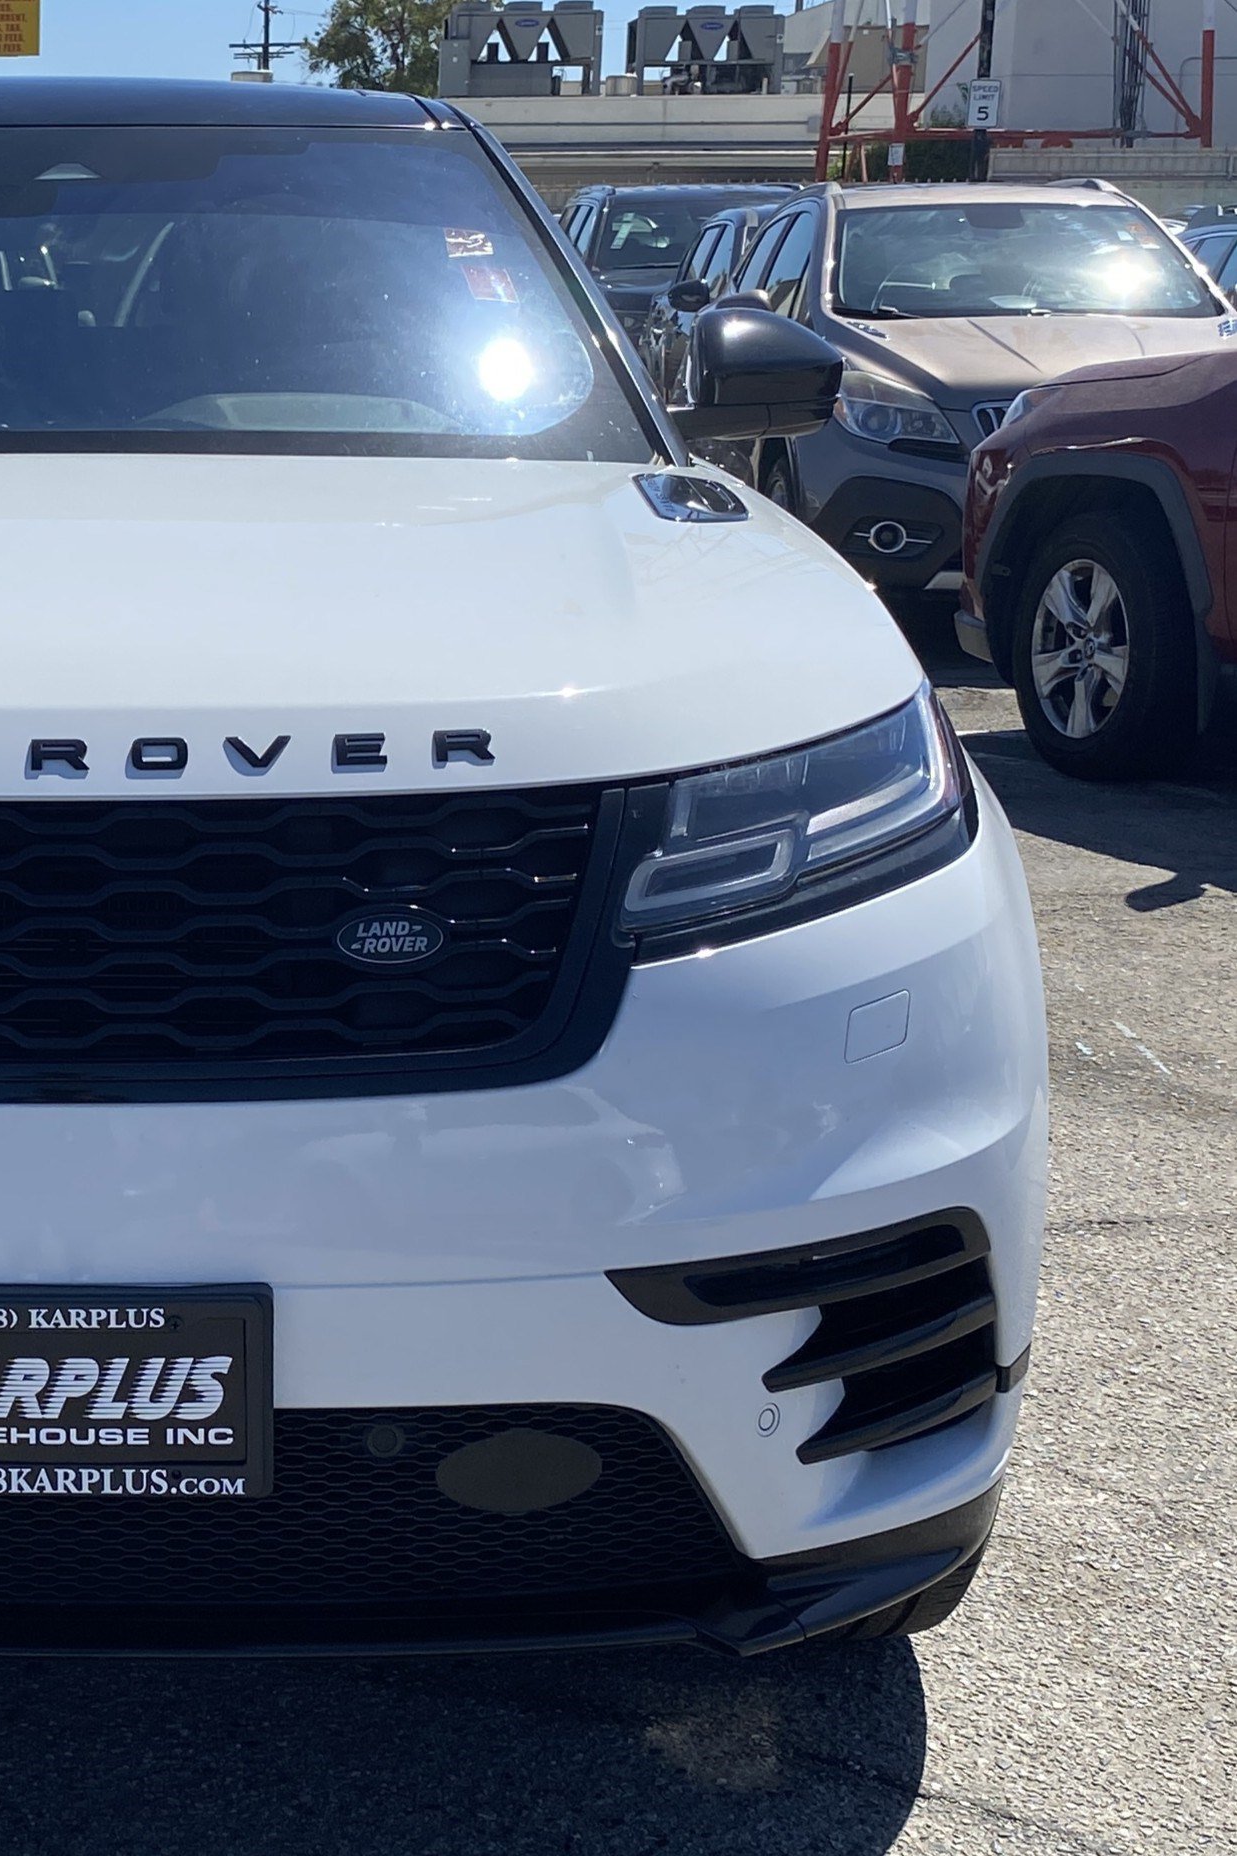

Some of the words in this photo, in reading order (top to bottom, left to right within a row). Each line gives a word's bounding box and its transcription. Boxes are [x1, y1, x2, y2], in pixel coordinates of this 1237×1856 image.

[972, 85, 999, 93] SPEED
[977, 106, 989, 121] 5
[30, 728, 496, 772] ROVER
[357, 921, 410, 938] LAND
[362, 936, 428, 954] ROVER
[28, 1308, 166, 1330] KARPLUS
[166, 1426, 235, 1446] INC
